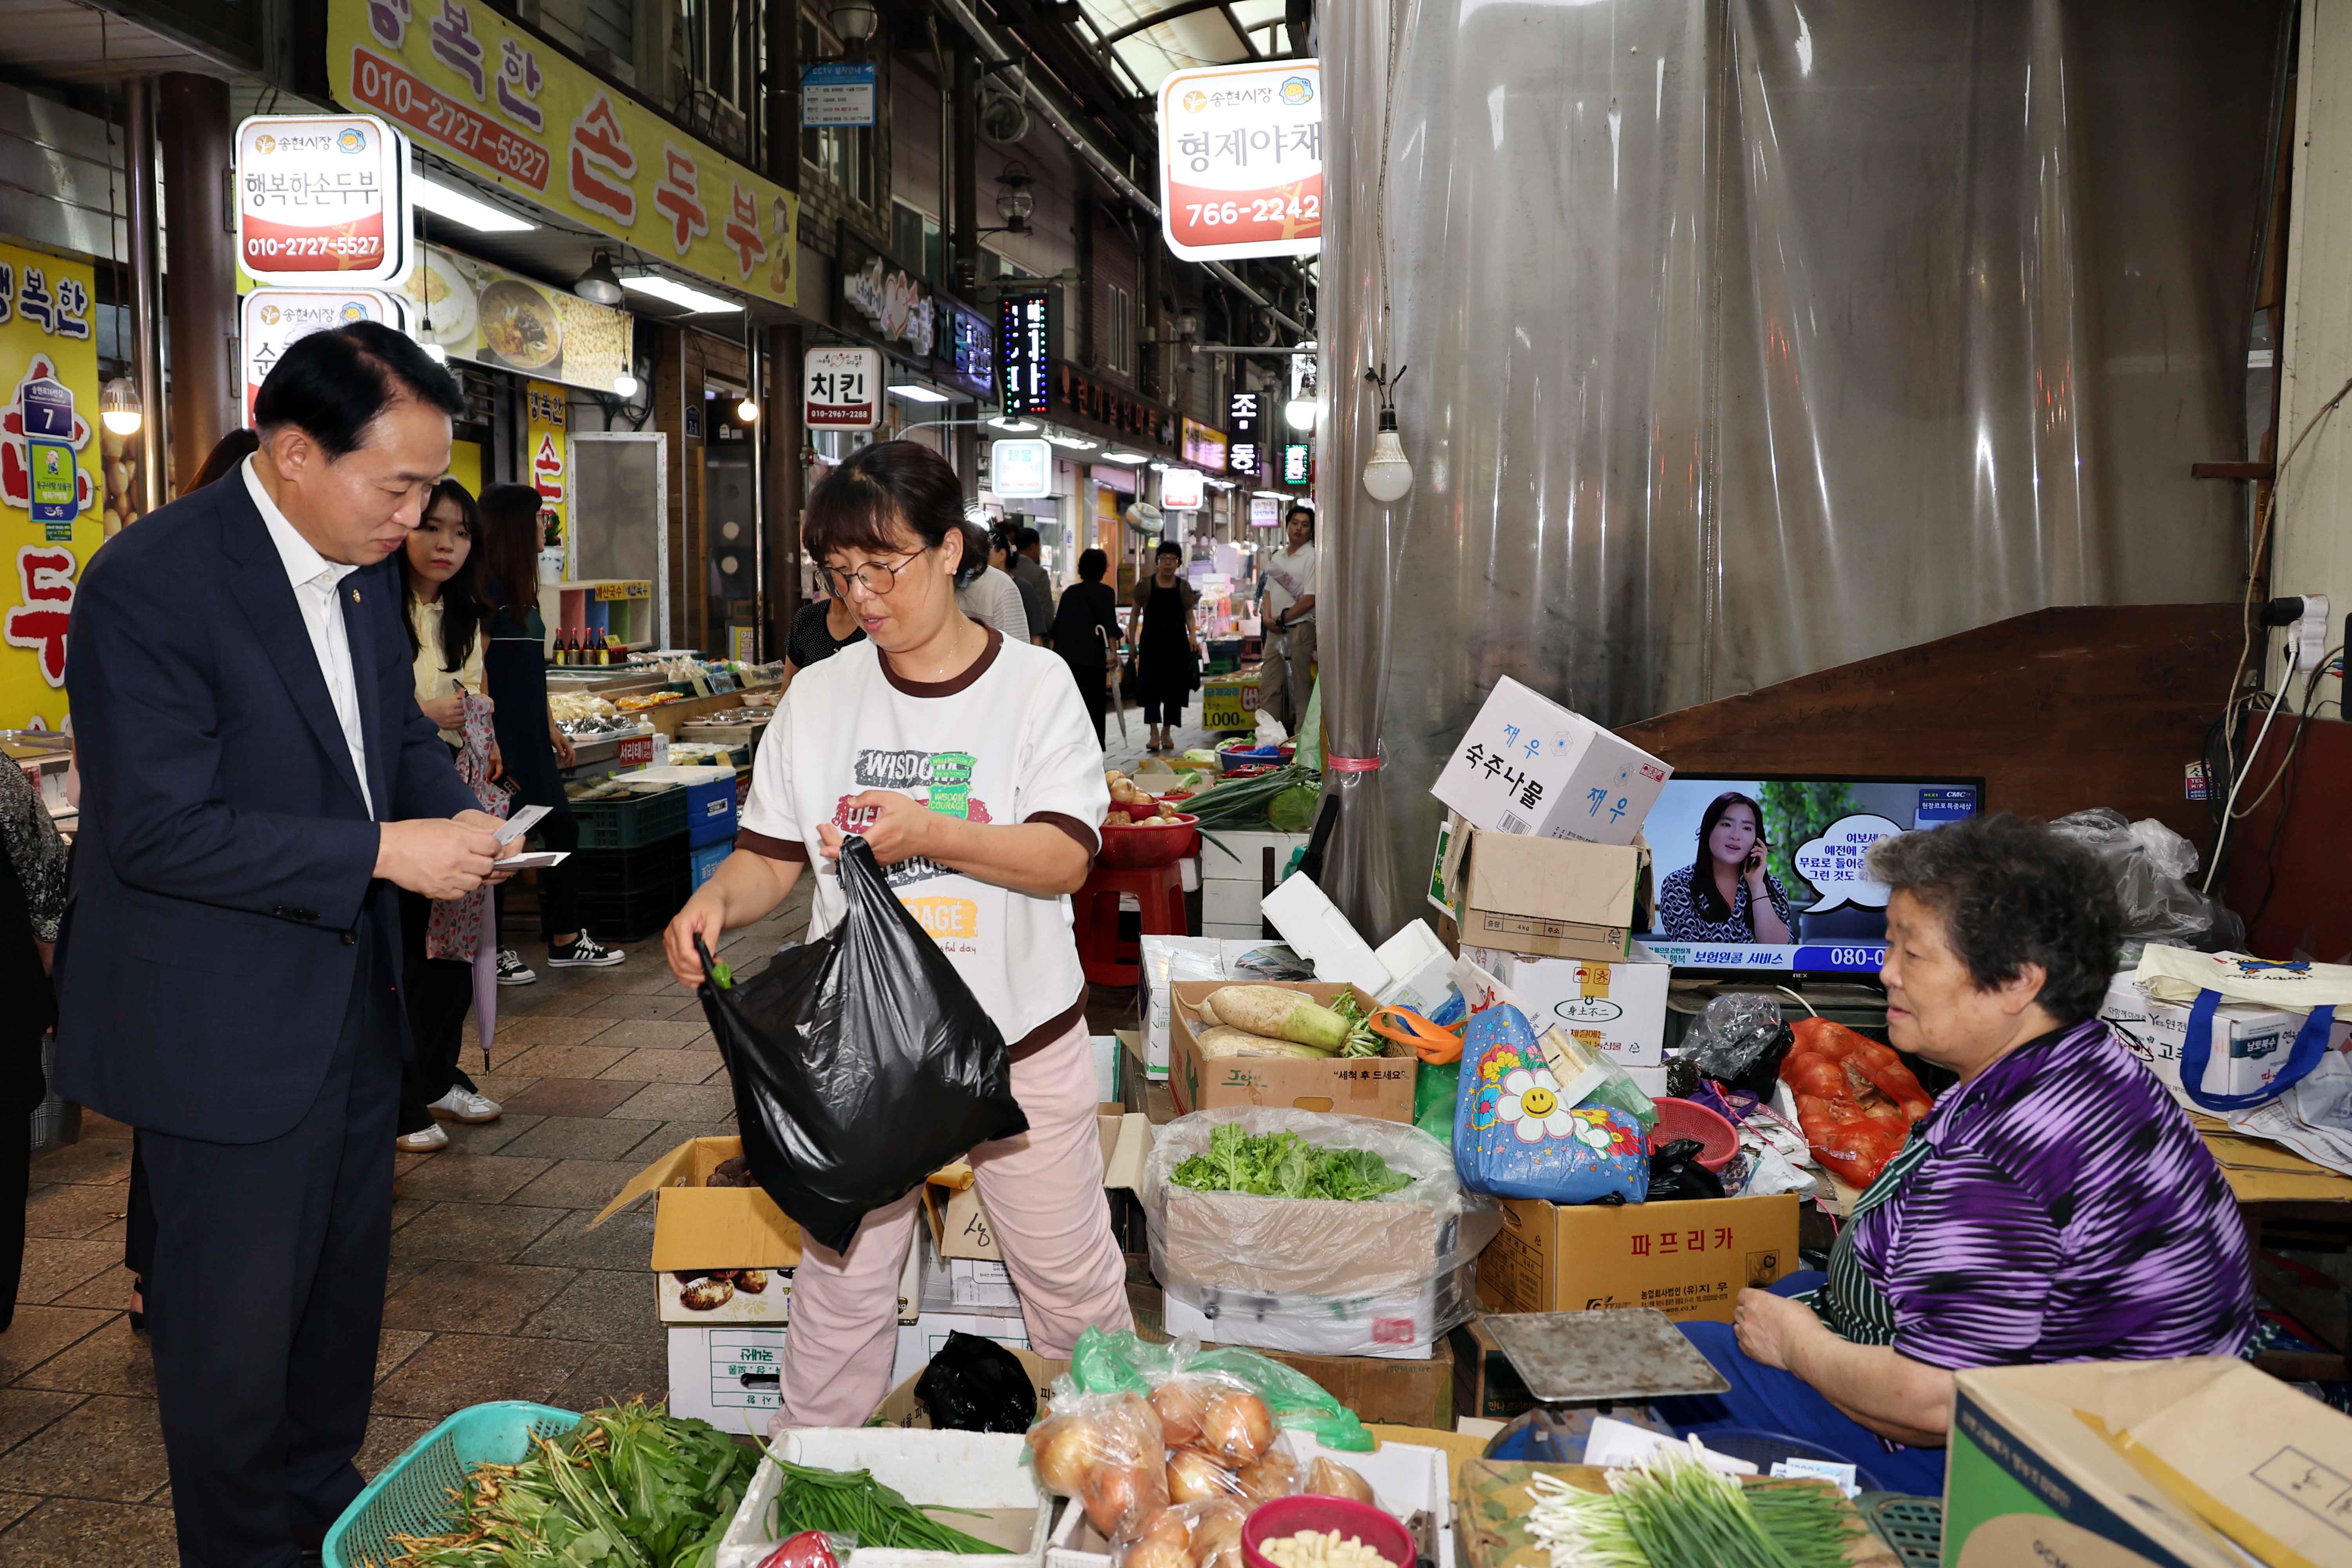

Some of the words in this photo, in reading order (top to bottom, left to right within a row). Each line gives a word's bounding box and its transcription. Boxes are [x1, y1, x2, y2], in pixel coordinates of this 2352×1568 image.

[1210, 87, 1272, 108] 송현시장
[361, 60, 546, 181] 010-2727-5527
[278, 136, 332, 151] 송현시장
[368, 0, 542, 127] 복한
[571, 96, 766, 273] 손두부
[1178, 121, 1321, 172] 형제야채
[245, 172, 378, 207] 행복한손두부
[1186, 195, 1319, 227] 766-2242
[248, 237, 378, 256] 010-2727-5527
[283, 308, 335, 322] 송현시장
[811, 372, 863, 403] 치킨
[530, 391, 563, 424] 행복한
[43, 408, 54, 430] 7
[1203, 711, 1240, 728] 1,000
[1503, 724, 1540, 759] 재우
[1466, 743, 1544, 810] 숙주나물
[931, 801, 965, 811] COURAGE
[1587, 787, 1628, 824] 재우
[1825, 845, 1857, 857] 예전에
[1800, 858, 1831, 868] 무료로
[1808, 871, 1829, 881] 그런
[1833, 871, 1855, 882] 것도
[959, 942, 976, 954] day
[1670, 955, 1686, 964] 행복
[1694, 952, 1743, 964] 보험원콜
[1746, 953, 1784, 965] 서비스
[1567, 1005, 1609, 1017] 身土不二
[1570, 1029, 1607, 1039] 체질에는
[1360, 1071, 1370, 1081] 후
[1631, 1227, 1734, 1257] 파프리카
[1641, 1287, 1681, 1300] 농업회사법인
[740, 1348, 773, 1361] 국내산
